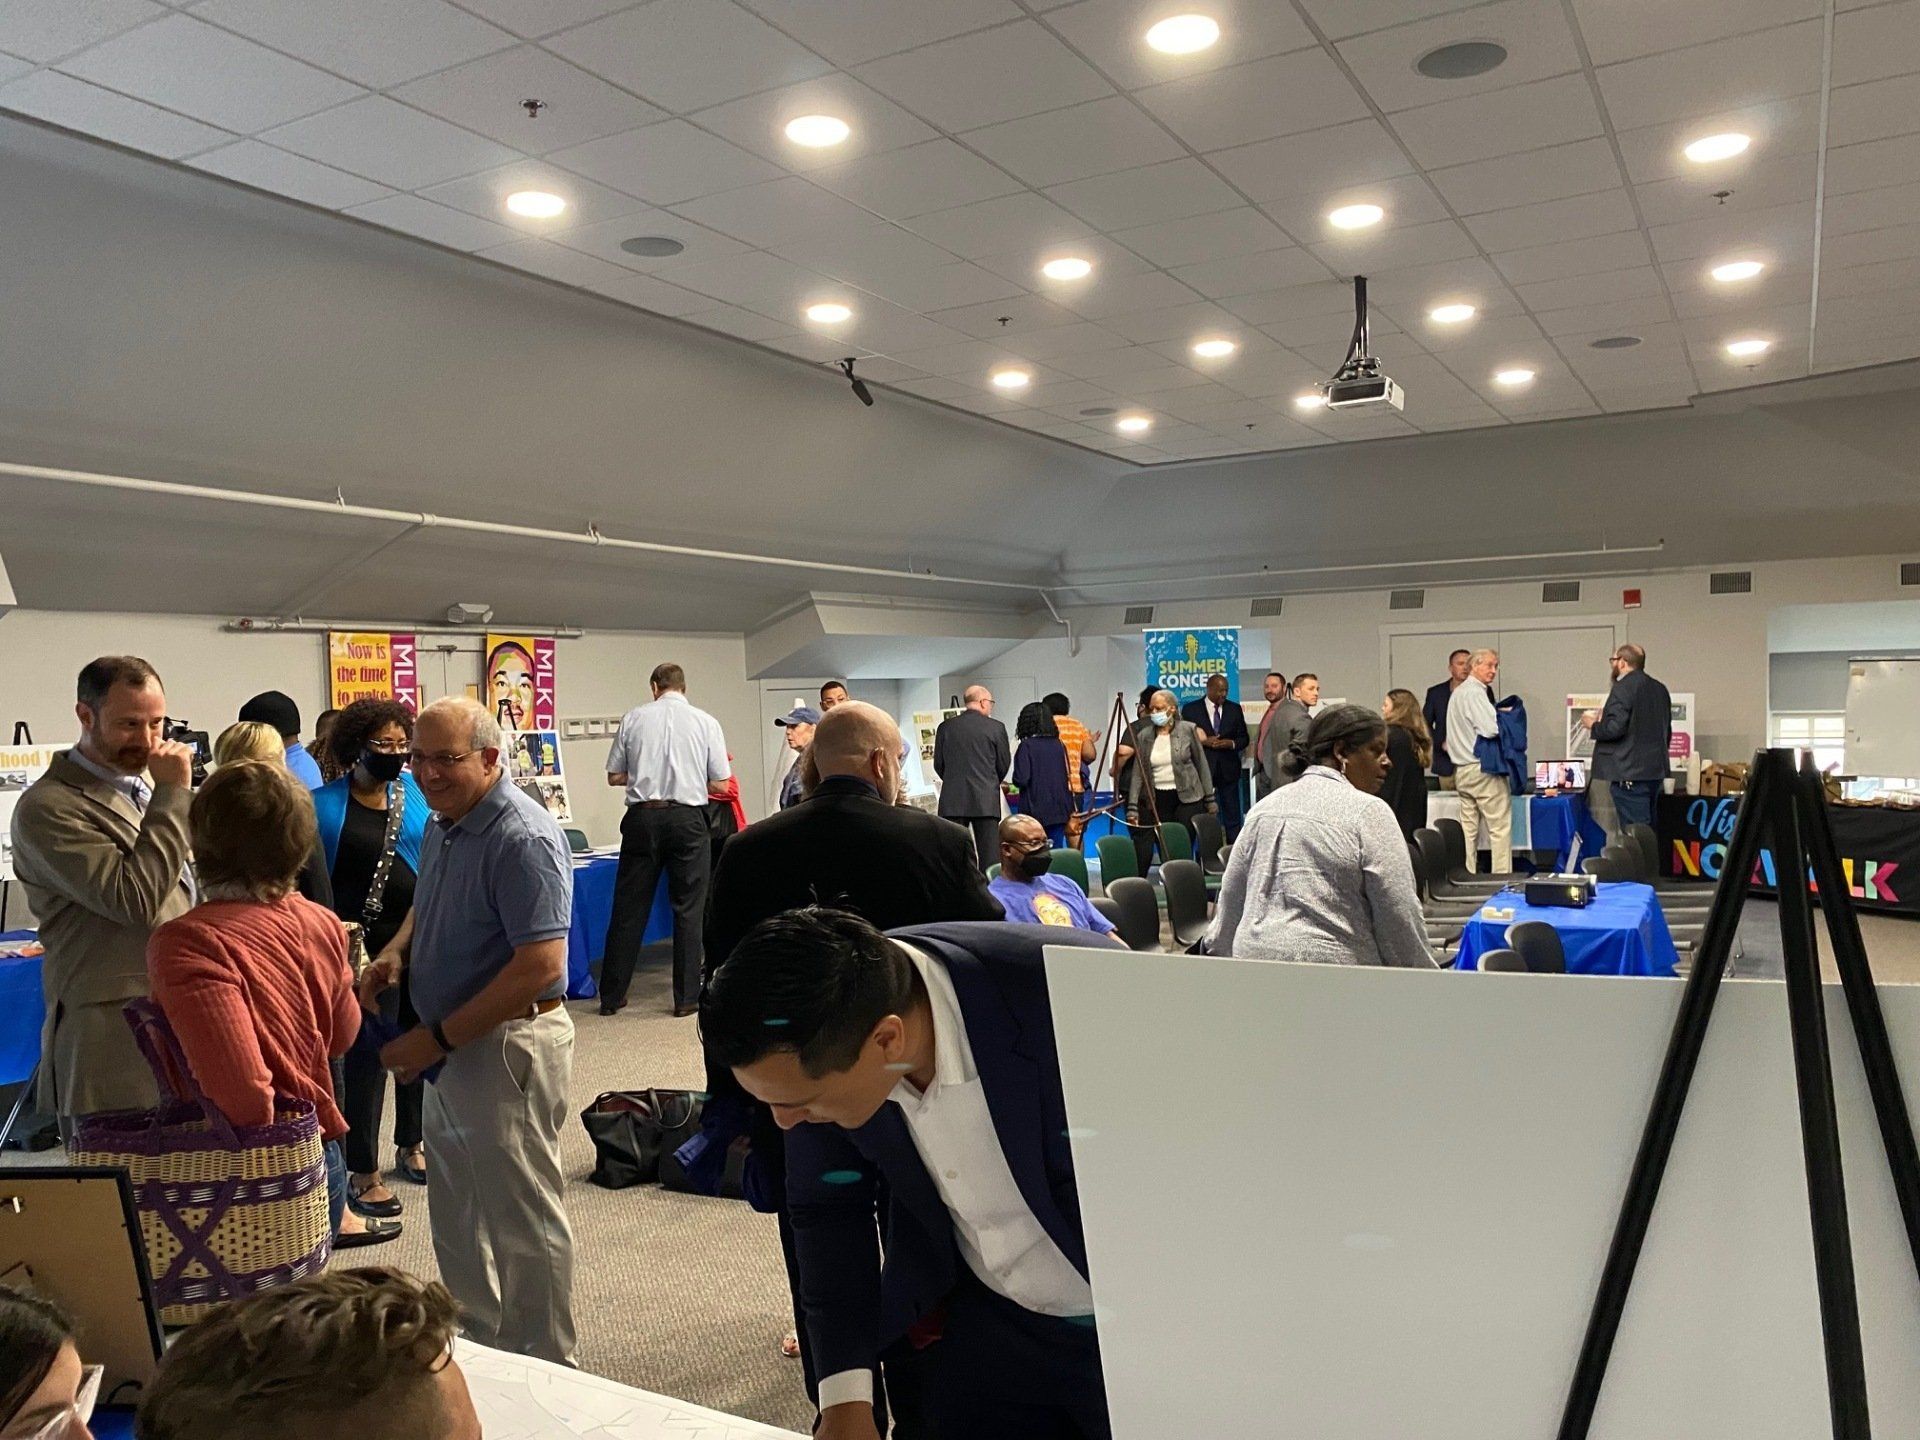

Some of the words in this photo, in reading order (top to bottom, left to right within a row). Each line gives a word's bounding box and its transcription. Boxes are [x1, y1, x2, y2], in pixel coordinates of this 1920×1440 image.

[347, 642, 373, 659] Now
[375, 643, 386, 659] is
[337, 666, 356, 682] the
[360, 666, 387, 682] time
[1159, 659, 1226, 674] SUMMER
[393, 644, 416, 707] MLK
[536, 649, 553, 706] MLK
[1158, 673, 1228, 688] CONCE
[337, 689, 350, 706] to
[536, 714, 552, 731] D
[1686, 798, 1738, 840] Vis
[1672, 838, 1900, 902] NOLK
